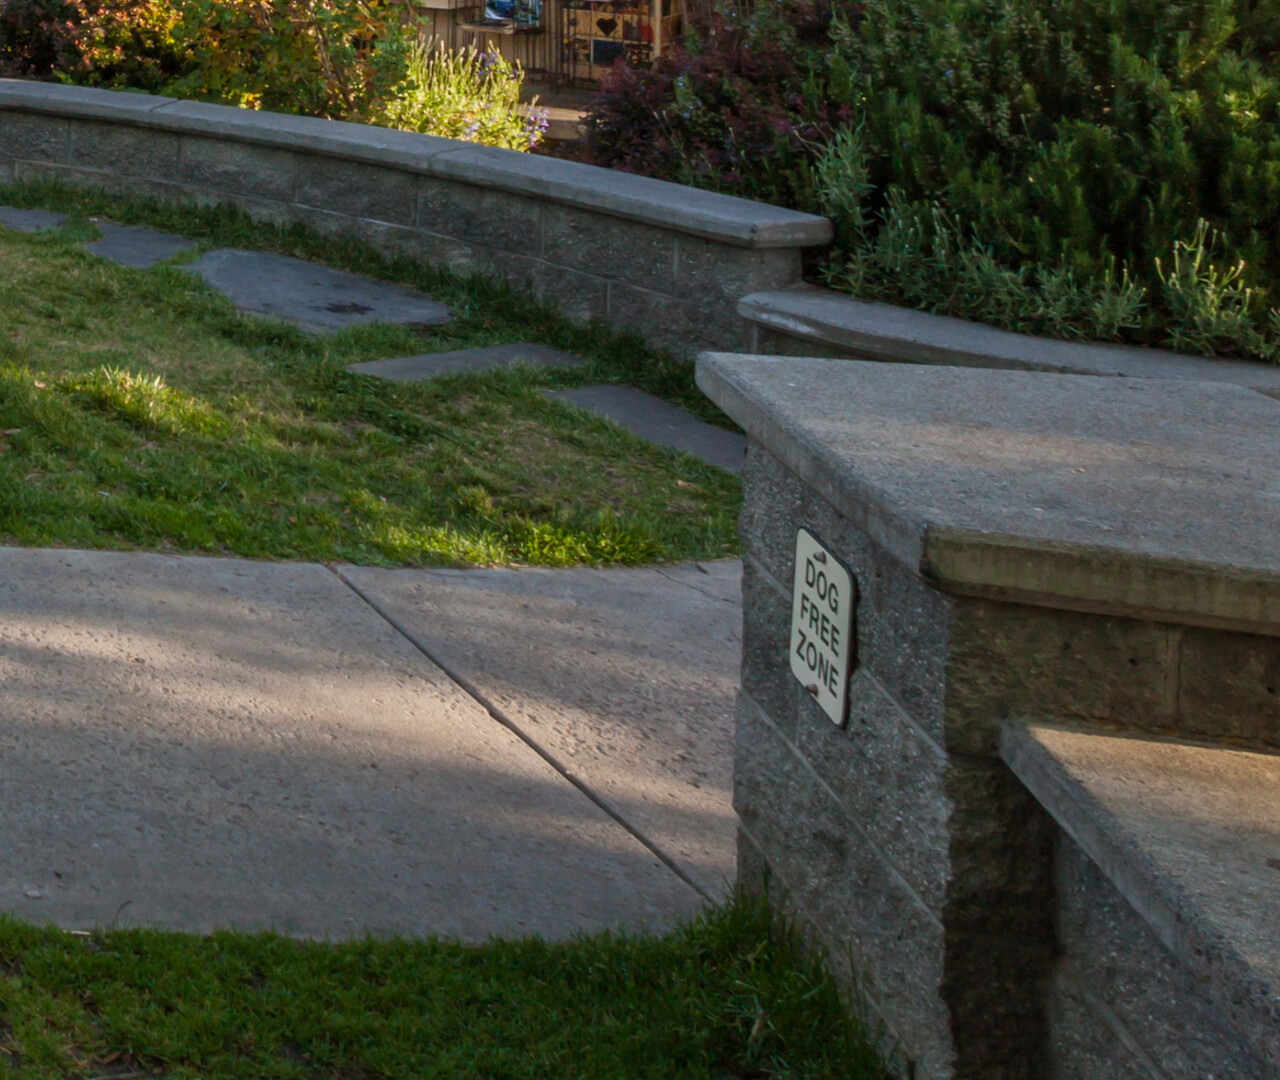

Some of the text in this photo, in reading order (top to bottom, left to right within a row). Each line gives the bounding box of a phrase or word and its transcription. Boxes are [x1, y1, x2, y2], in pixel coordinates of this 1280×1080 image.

[805, 557, 839, 616] DOG
[800, 591, 840, 658] FREE
[796, 628, 839, 698] ZONE
